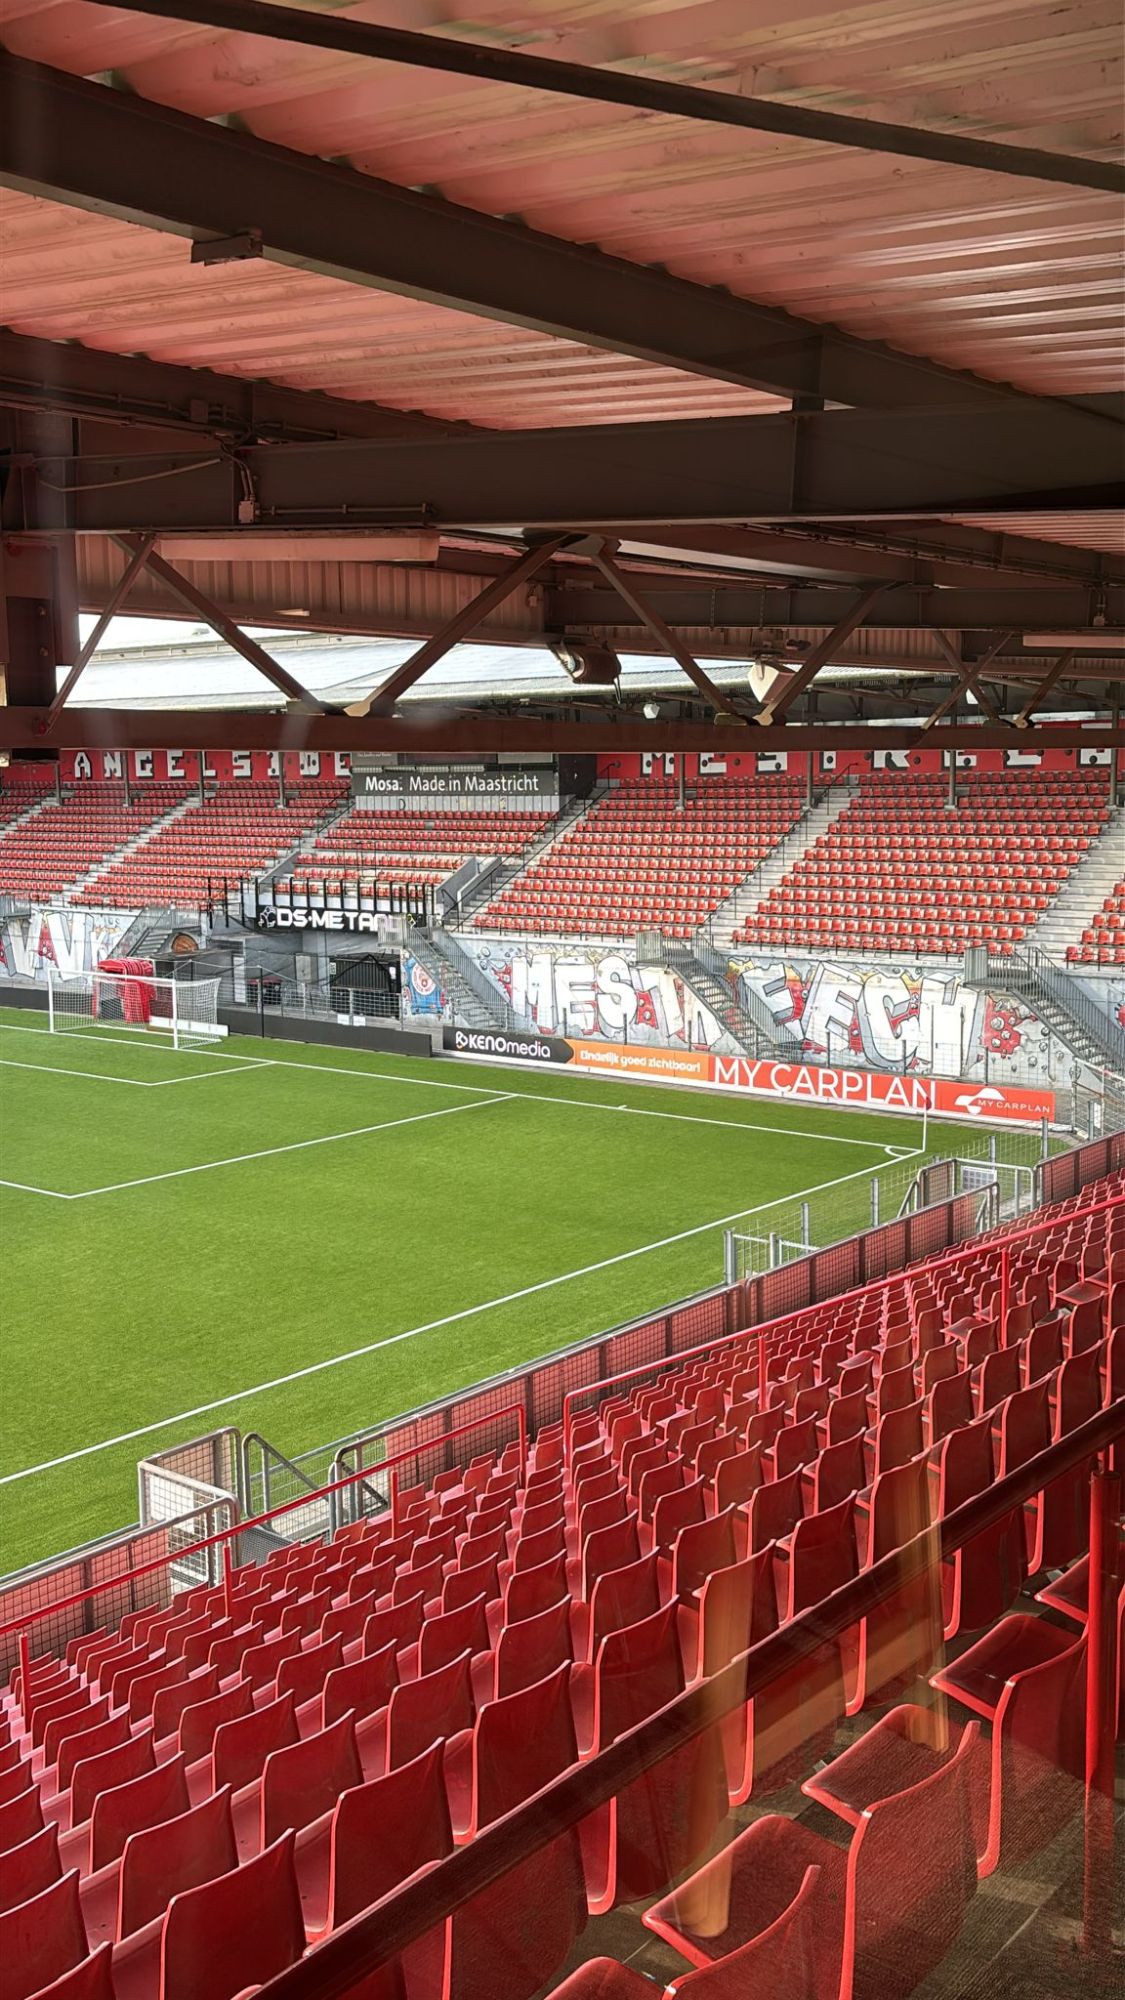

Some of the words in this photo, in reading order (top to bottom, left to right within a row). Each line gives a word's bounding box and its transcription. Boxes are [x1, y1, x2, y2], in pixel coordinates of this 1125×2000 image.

[365, 776, 403, 791] Mosa.
[409, 776, 446, 791] Made
[449, 776, 461, 791] in
[464, 774, 539, 791] Maastricht
[620, 1055, 647, 1067] goed
[714, 1056, 763, 1087] MY
[770, 1063, 936, 1111] CARPLAN
[977, 1099, 994, 1107] MY
[996, 1101, 1050, 1113] CARPLAN
